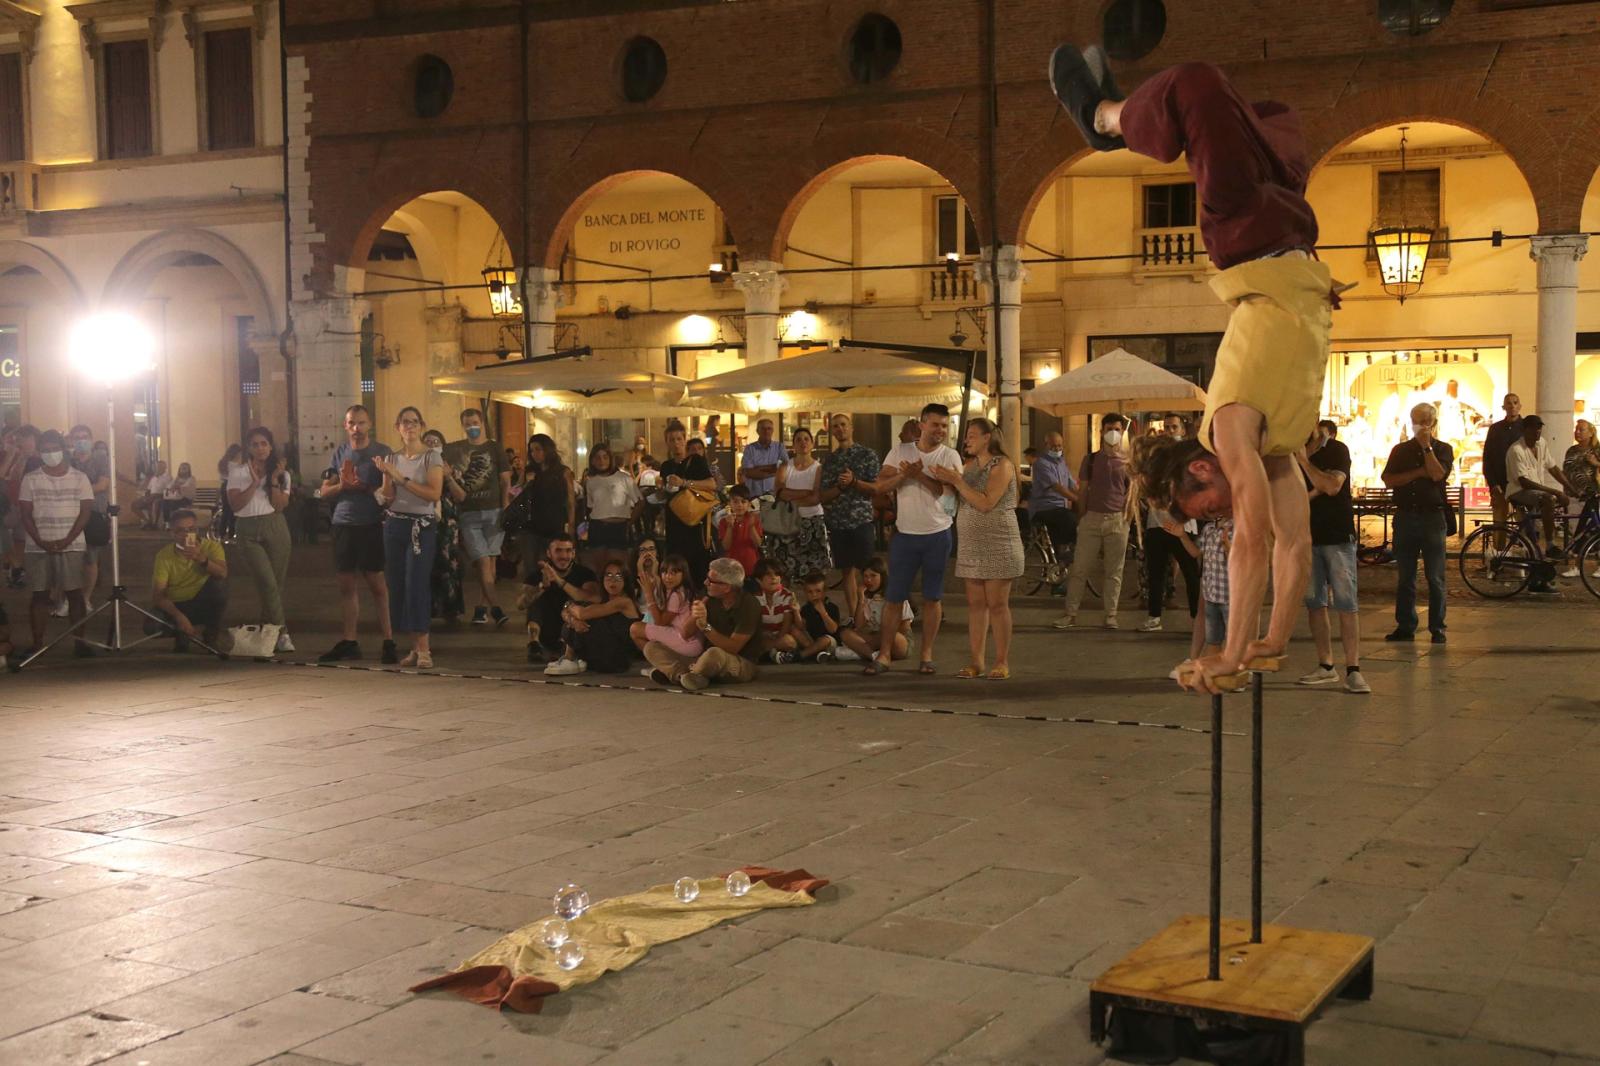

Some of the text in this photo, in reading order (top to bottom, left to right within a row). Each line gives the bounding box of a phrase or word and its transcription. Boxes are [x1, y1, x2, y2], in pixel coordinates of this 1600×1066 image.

[585, 209, 705, 227] BANCA DEL MONTE
[610, 238, 681, 253] DI ROVIGO
[1379, 367, 1401, 381] LOVE
